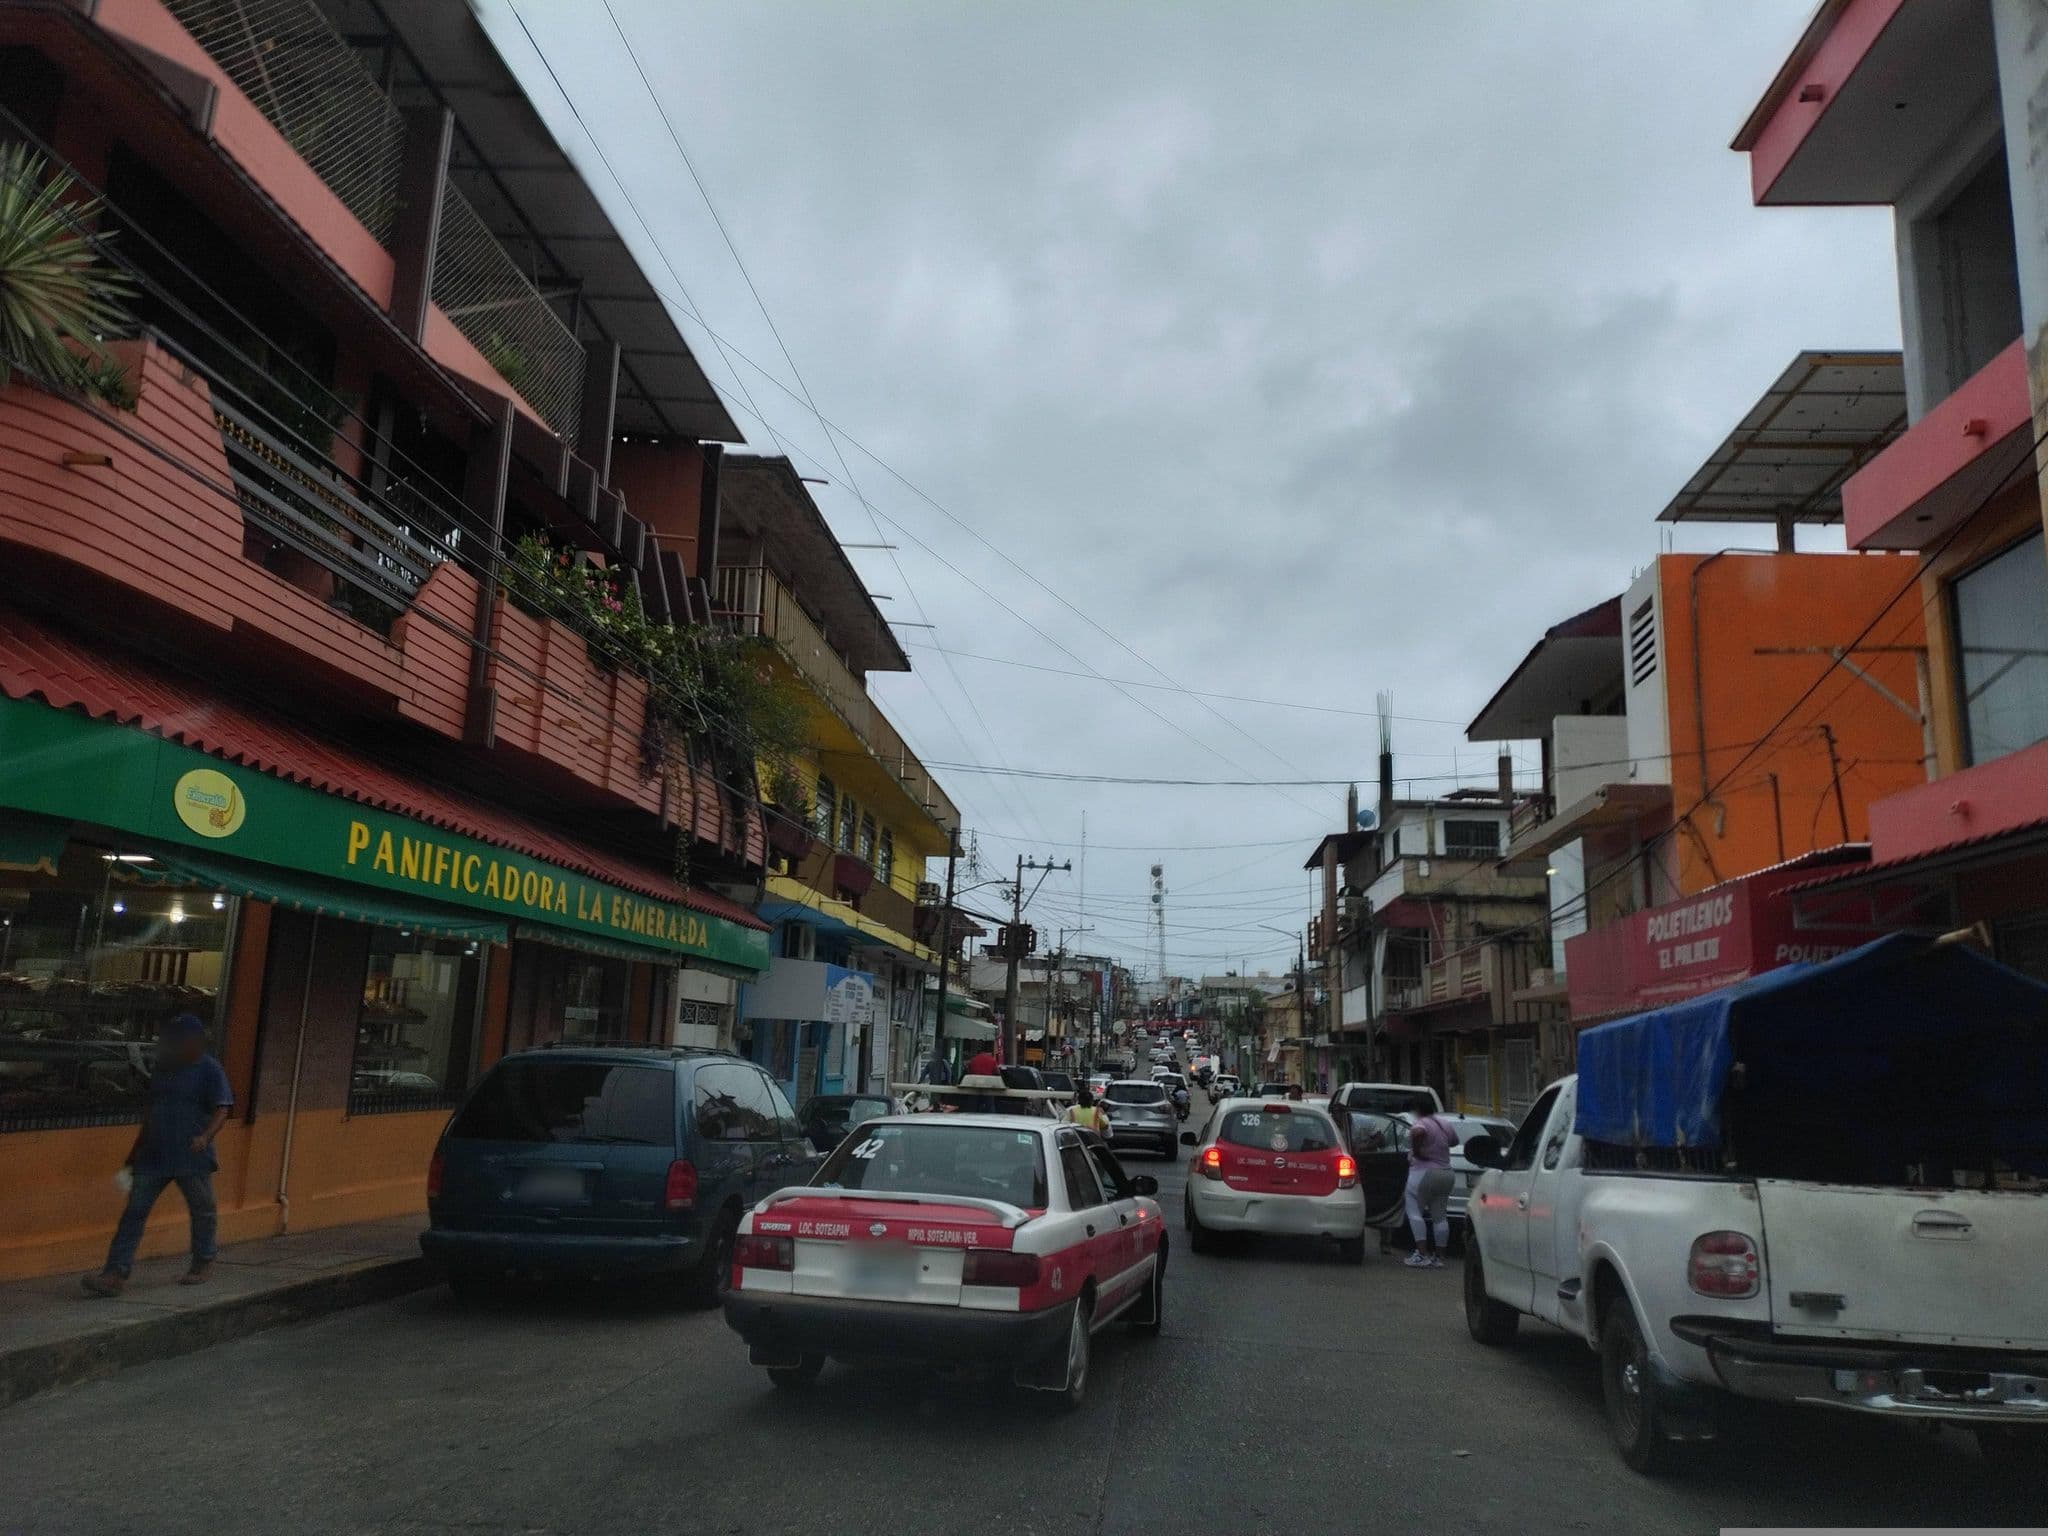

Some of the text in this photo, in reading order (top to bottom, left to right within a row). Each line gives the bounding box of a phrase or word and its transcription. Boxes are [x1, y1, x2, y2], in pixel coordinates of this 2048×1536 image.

[347, 821, 708, 949] PANIFICADORA LA ESMERALDA
[1646, 893, 1734, 945] POLIETILENOS
[1658, 947, 1673, 969] EL
[1241, 1113, 1260, 1126] 326
[851, 1138, 885, 1159] 42
[798, 1221, 814, 1234] LOC.
[815, 1222, 850, 1236] SOTEAPAN
